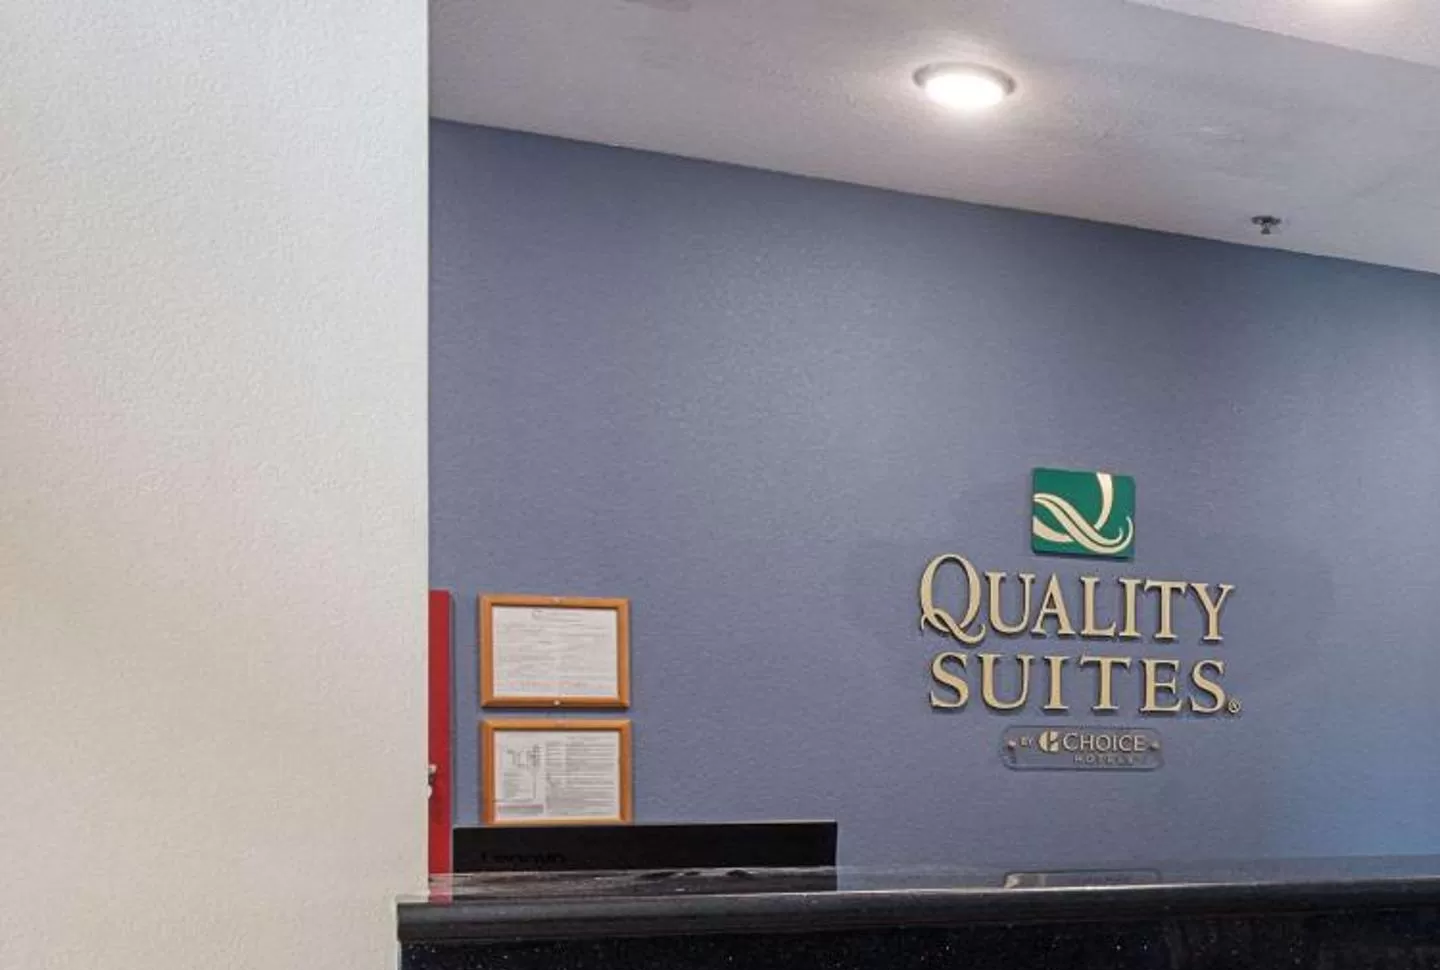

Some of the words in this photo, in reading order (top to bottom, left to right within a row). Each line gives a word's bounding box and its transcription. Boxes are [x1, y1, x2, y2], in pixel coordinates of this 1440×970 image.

[920, 554, 1235, 643] QUALITY
[930, 652, 1226, 713] SUITES
[1062, 732, 1146, 752] CHOICE
